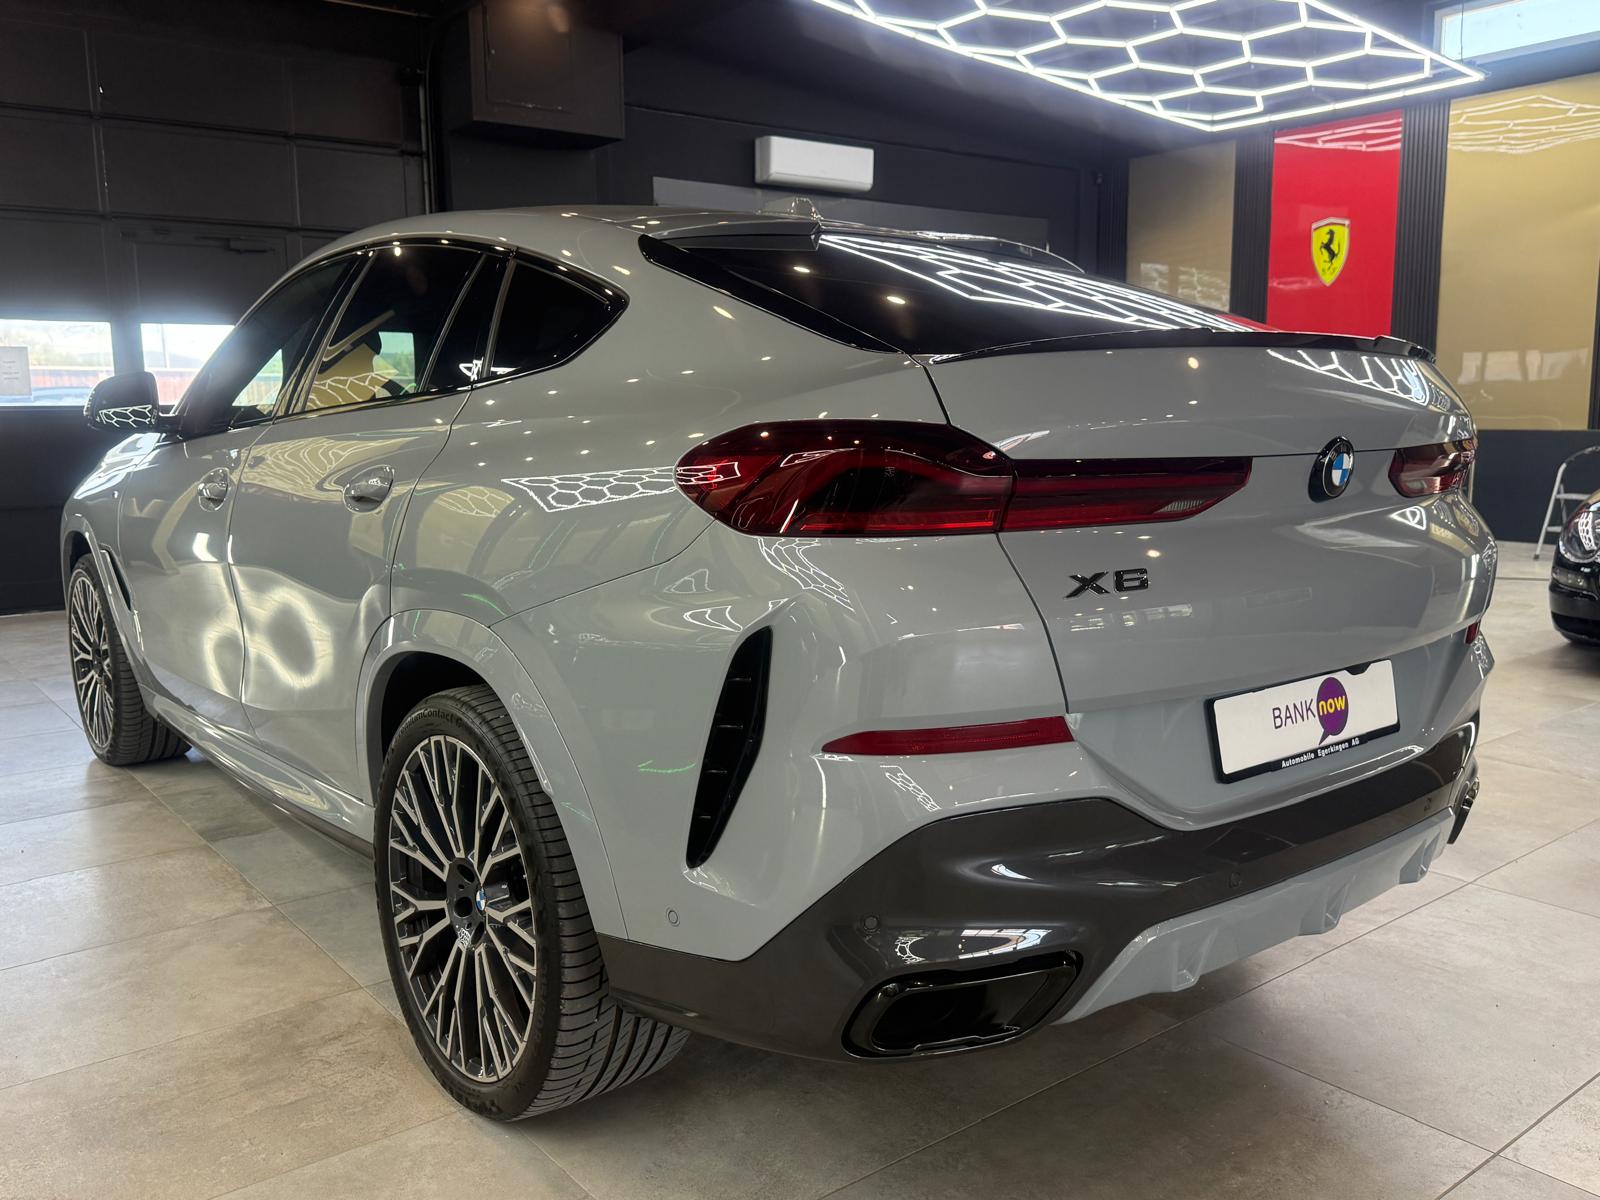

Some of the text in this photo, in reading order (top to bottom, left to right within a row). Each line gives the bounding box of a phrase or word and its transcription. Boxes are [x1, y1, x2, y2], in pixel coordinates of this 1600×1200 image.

[1065, 568, 1149, 599] X6
[1272, 695, 1346, 729] BANK now
[1281, 737, 1360, 768] Automobile Egerkingen AG
